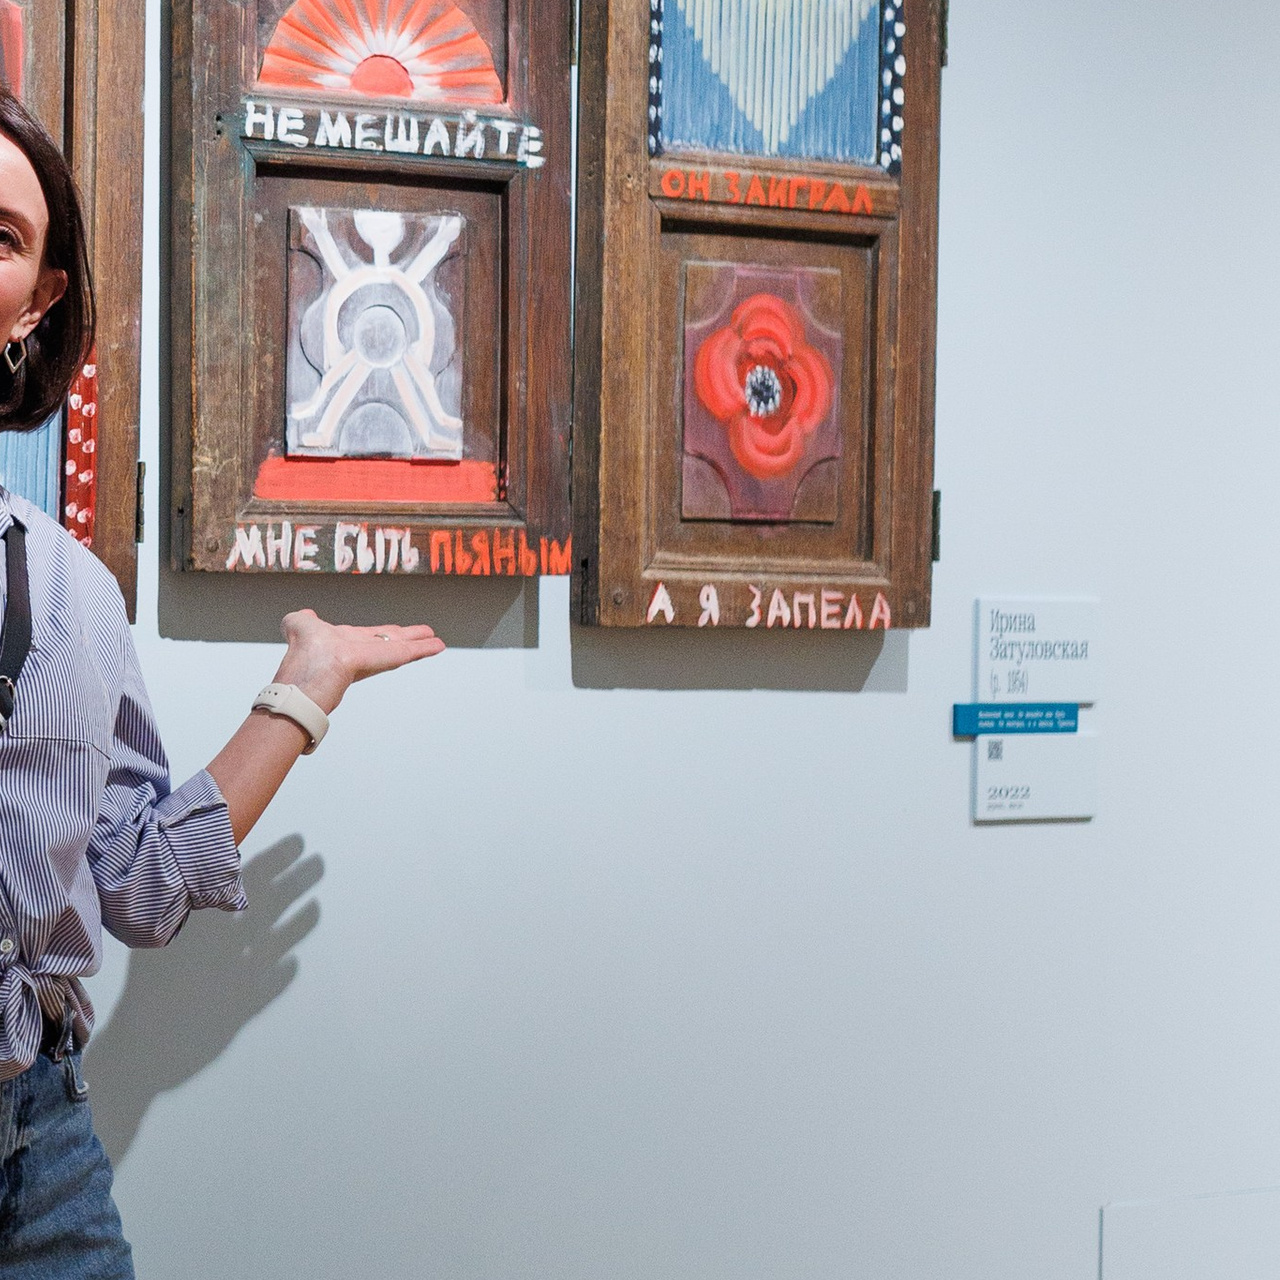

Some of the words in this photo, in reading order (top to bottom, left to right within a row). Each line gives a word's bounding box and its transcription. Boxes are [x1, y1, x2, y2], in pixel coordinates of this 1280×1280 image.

[244, 101, 309, 148] НЕ
[314, 109, 546, 168] МЕШАЙТЕ
[660, 169, 711, 202] ОН
[724, 170, 875, 216] ЗАИГРАЛ
[225, 520, 321, 571] МНЕ
[334, 520, 420, 575] БЫТЬ
[430, 525, 573, 577] ПЬЯНЫМ
[646, 580, 676, 625] А
[697, 582, 720, 628] Я
[745, 583, 892, 630] ЗАПЕЛА
[990, 608, 1037, 639] Ирина
[989, 636, 1089, 666] Затуловская
